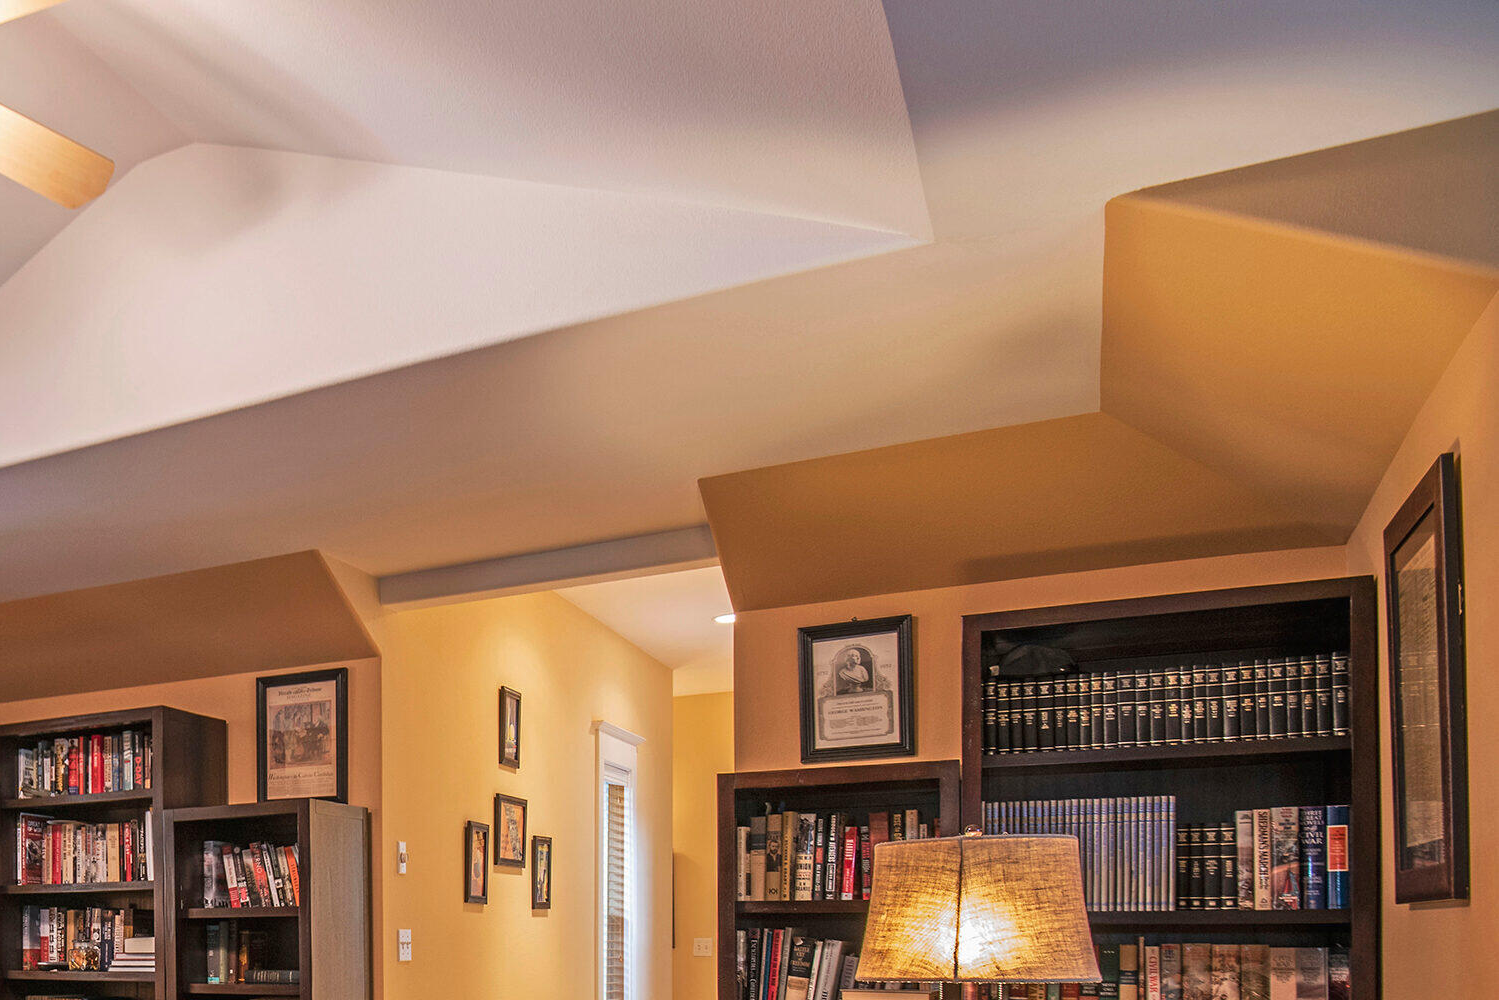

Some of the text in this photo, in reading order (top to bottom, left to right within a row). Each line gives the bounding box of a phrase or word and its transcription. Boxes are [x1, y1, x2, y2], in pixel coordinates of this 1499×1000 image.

[252, 843, 263, 873] INFERNO
[1258, 811, 1269, 877] SHERMAN'S MARCH
[291, 863, 299, 894] STALINGRAD
[1149, 956, 1158, 992] CIVIL WAR
